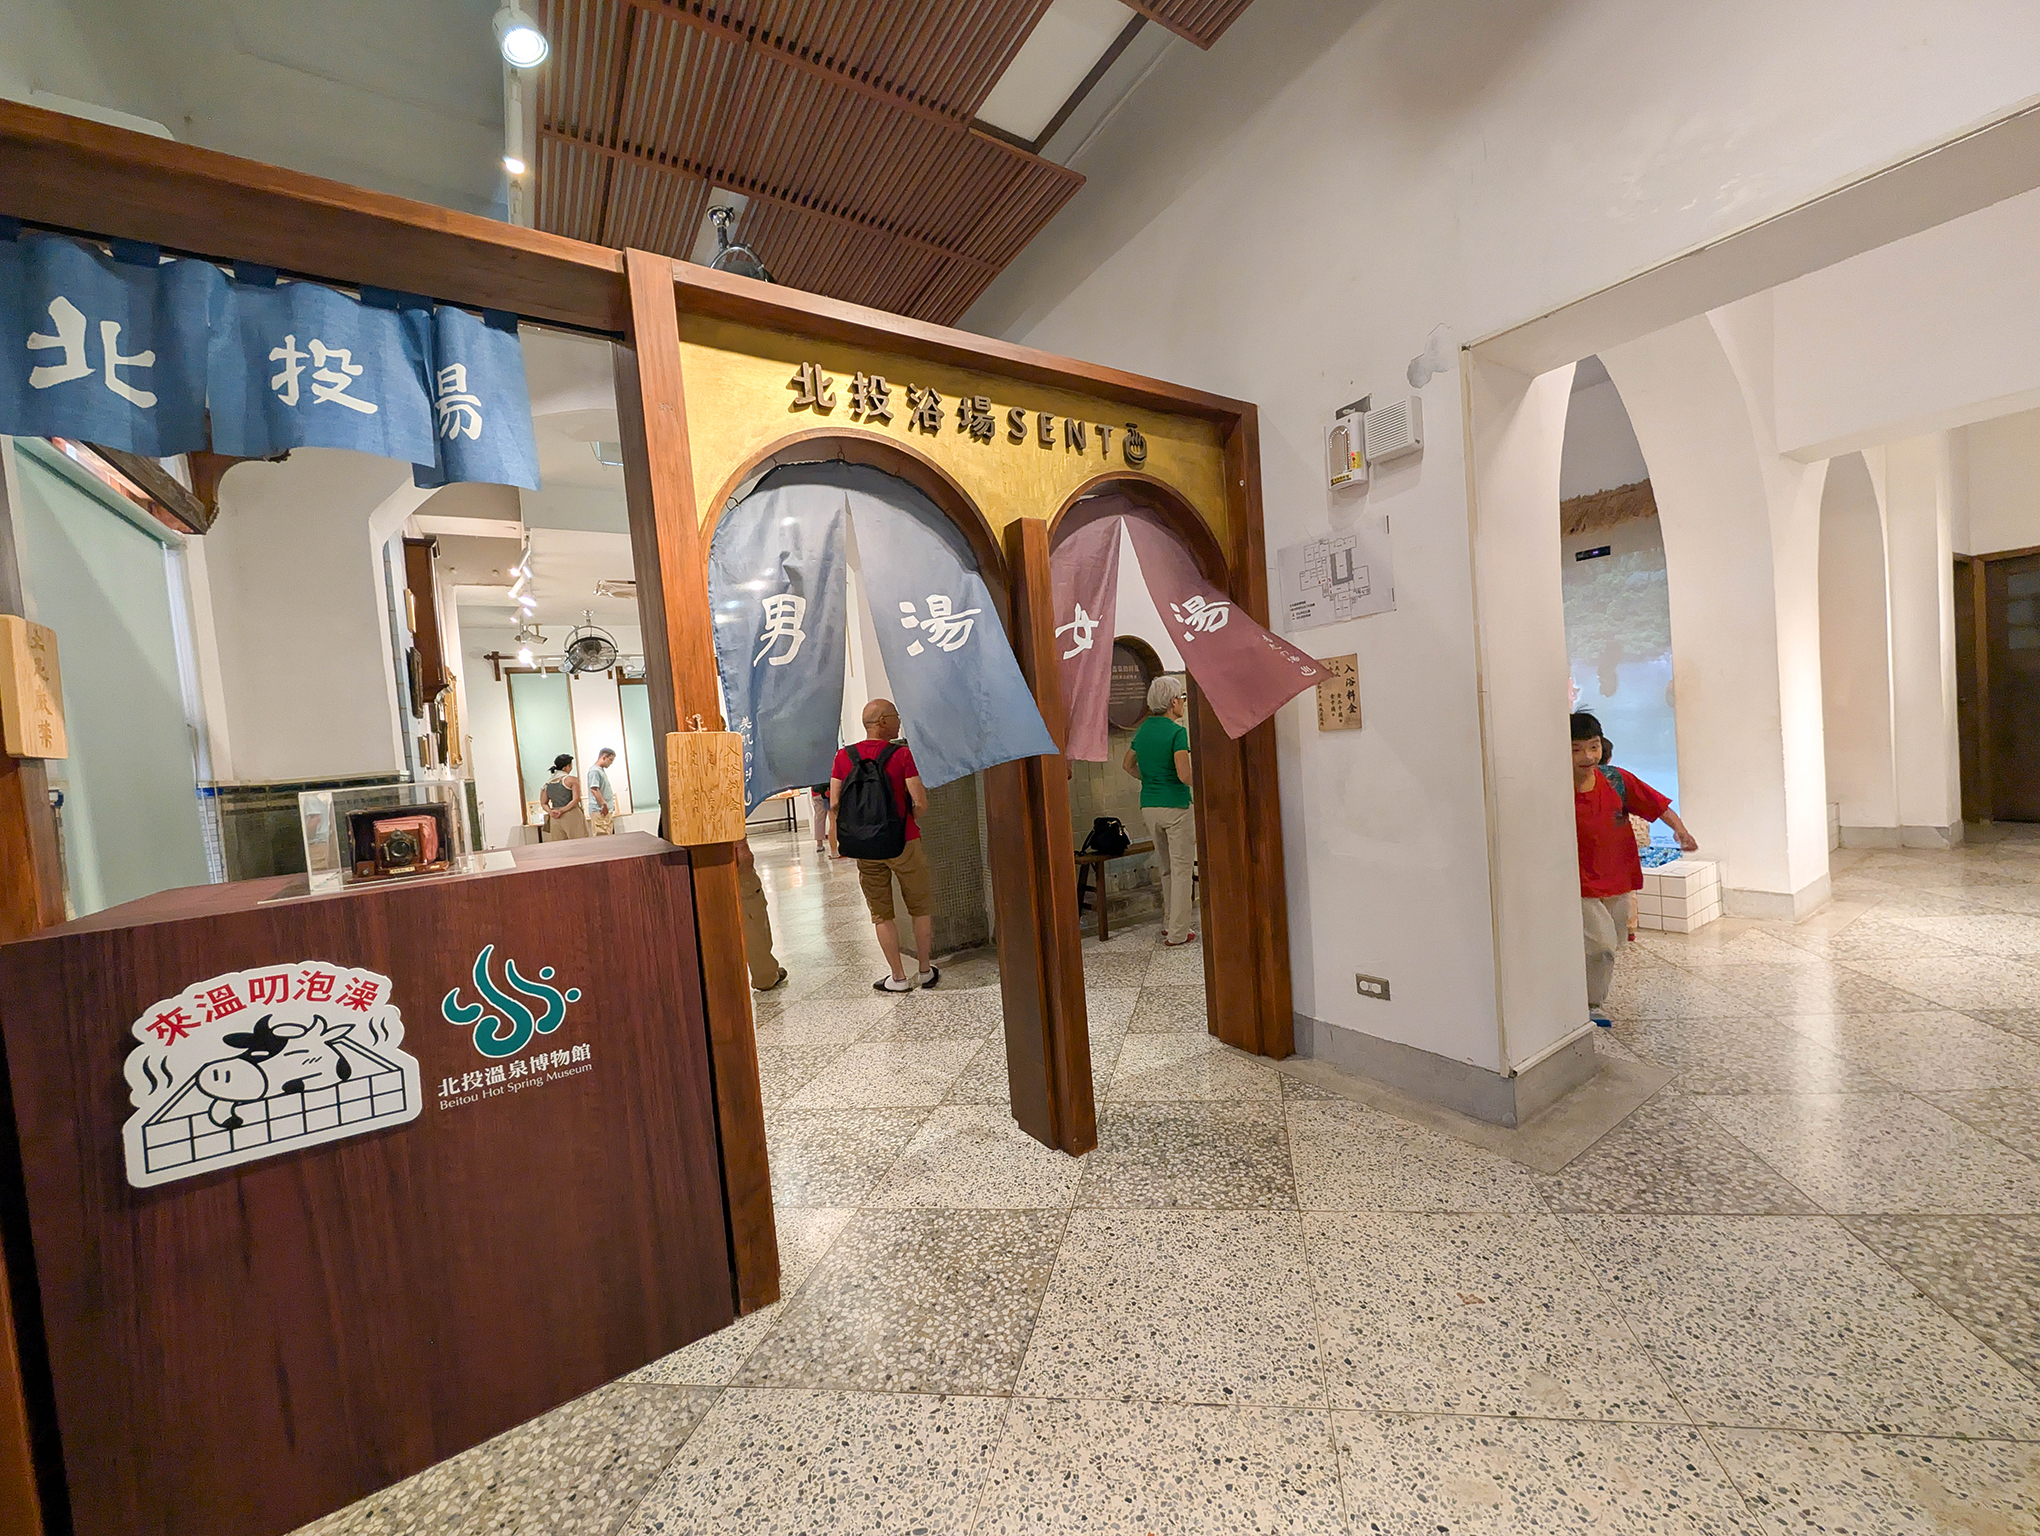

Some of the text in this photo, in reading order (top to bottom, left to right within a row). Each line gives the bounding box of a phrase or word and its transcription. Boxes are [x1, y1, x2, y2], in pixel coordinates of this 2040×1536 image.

[788, 362, 996, 440] 北投浴場
[1344, 664, 1358, 714] 入浴料金
[440, 1063, 592, 1110] Beitou Hot Spring Museum
